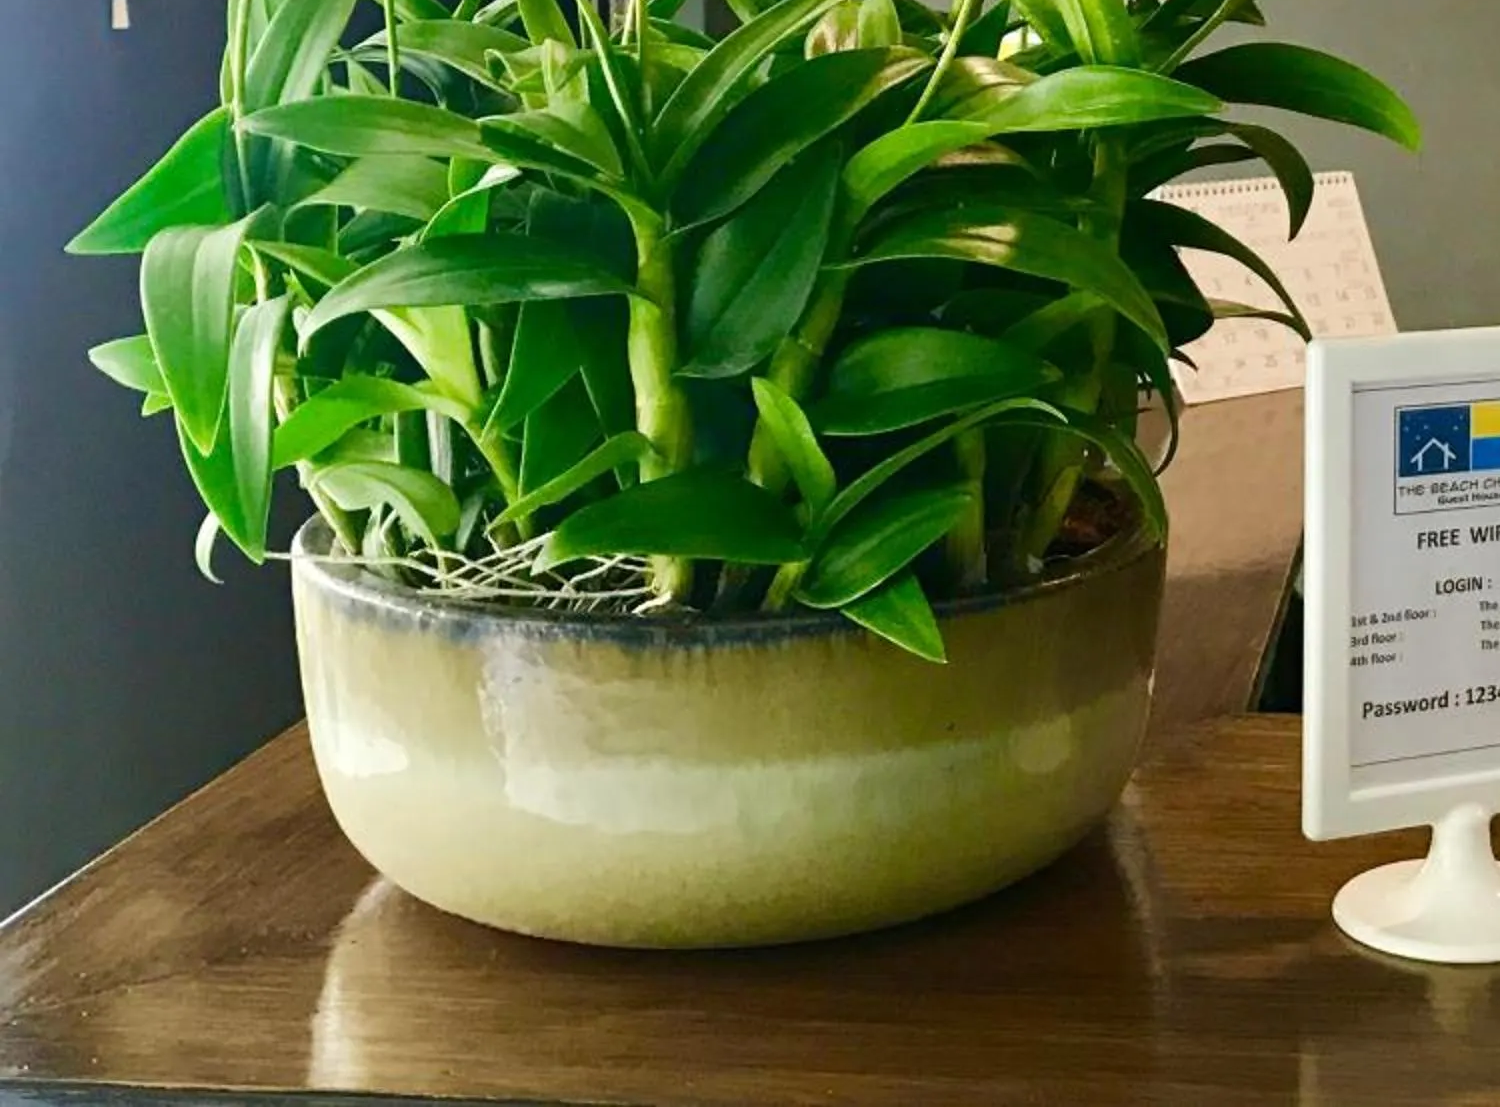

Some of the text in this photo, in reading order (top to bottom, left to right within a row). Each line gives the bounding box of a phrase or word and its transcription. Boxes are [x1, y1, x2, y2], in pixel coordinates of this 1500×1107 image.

[1398, 484, 1425, 497] THE
[1430, 479, 1479, 494] BEACH
[1437, 493, 1469, 505] Guest
[1417, 528, 1461, 550] FREE
[1435, 576, 1483, 595] LOGIN
[1381, 610, 1402, 623] 2nd
[1404, 608, 1430, 621] floor
[1479, 599, 1498, 611] The
[1350, 634, 1369, 648] 3rd
[1371, 632, 1397, 645] floor
[1480, 619, 1500, 631] The
[1350, 654, 1368, 667] 4th
[1371, 652, 1397, 666] floor
[1481, 639, 1500, 650] The
[1362, 690, 1449, 720] Password
